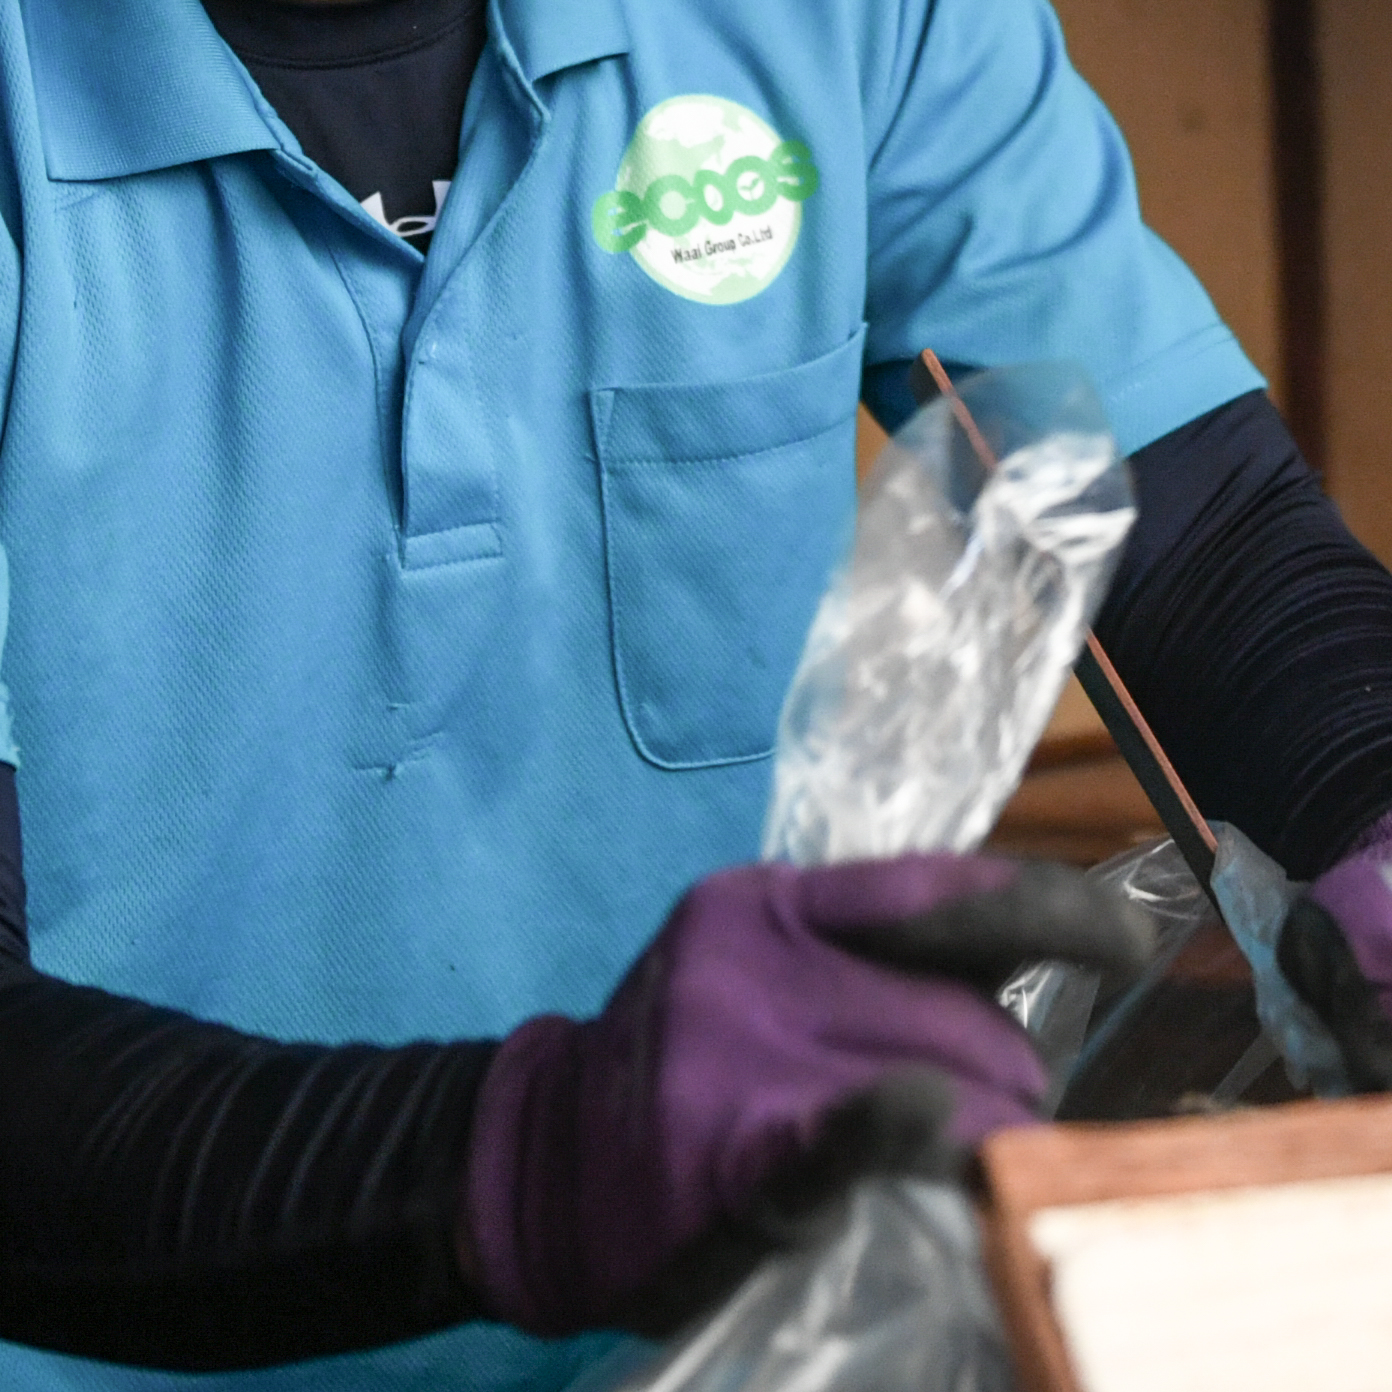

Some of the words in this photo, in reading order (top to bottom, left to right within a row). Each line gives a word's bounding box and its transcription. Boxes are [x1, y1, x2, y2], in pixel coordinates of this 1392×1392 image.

[593, 141, 819, 253] ecoos
[671, 248, 702, 264] Waai
[704, 238, 736, 256] Group
